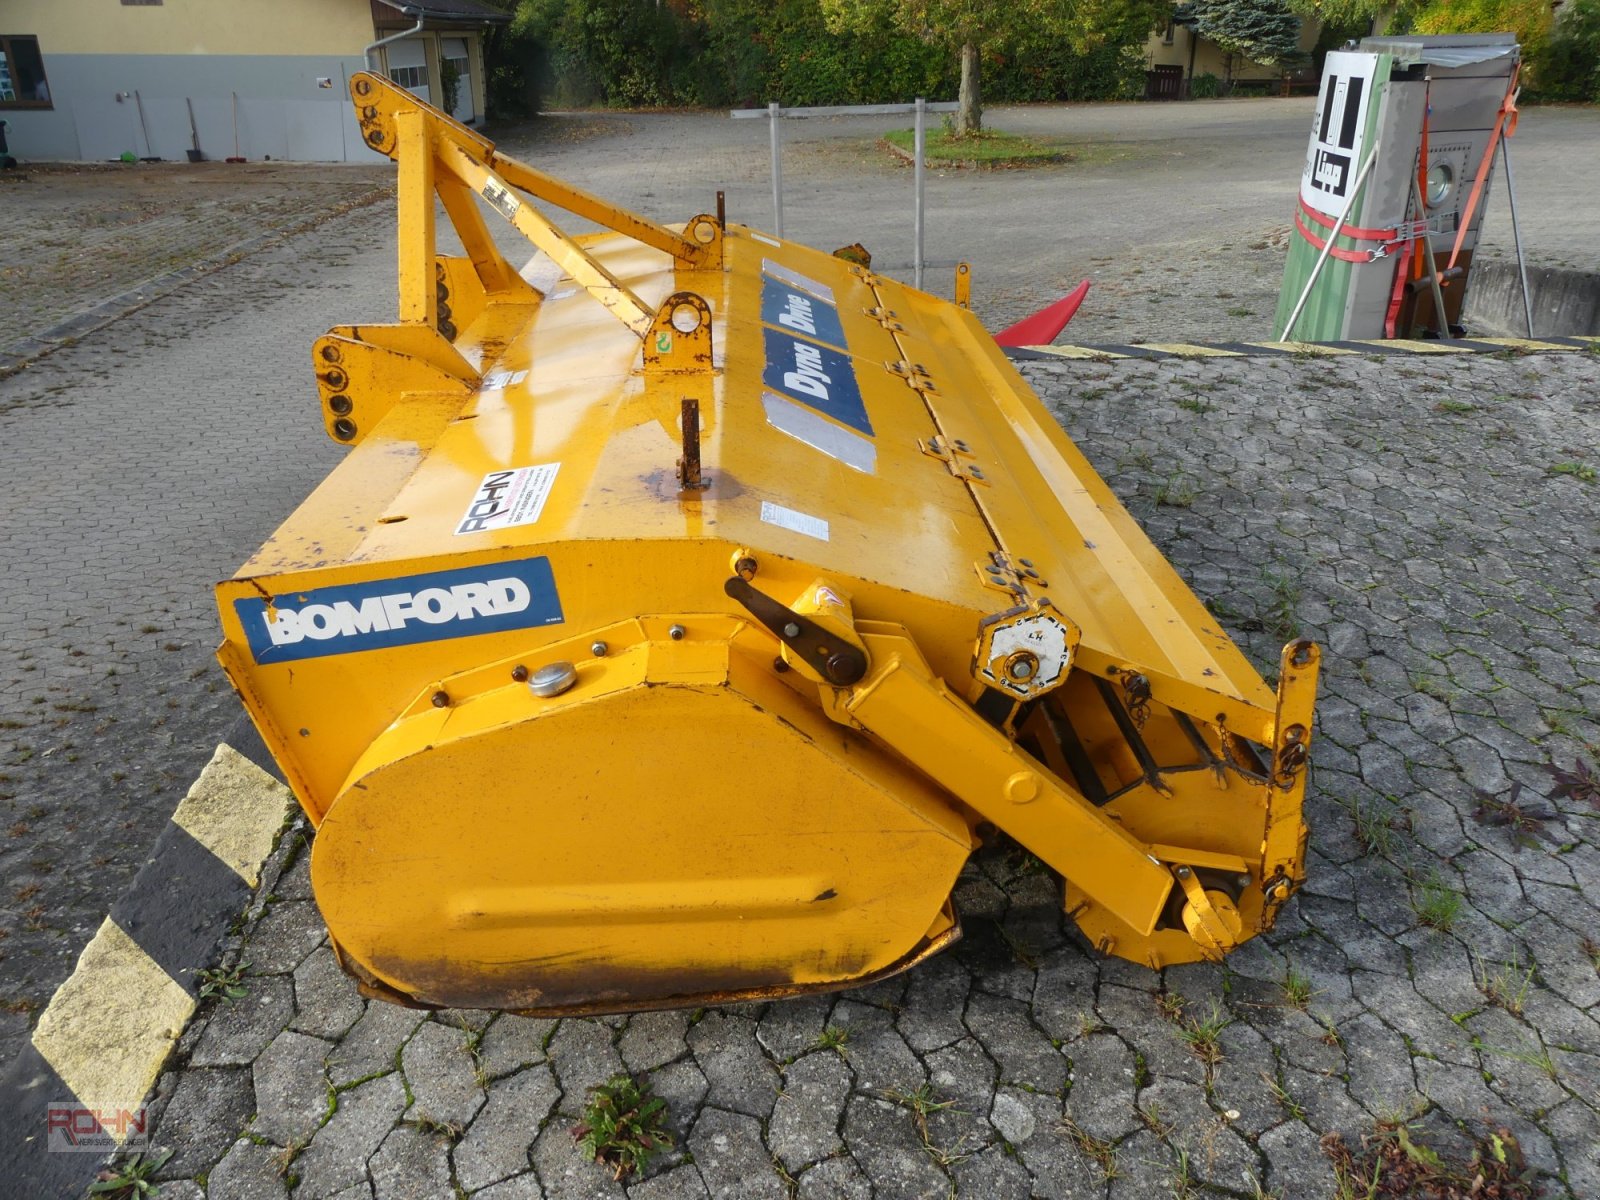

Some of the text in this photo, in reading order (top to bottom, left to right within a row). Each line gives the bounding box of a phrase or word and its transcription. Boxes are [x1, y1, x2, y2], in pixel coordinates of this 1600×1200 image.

[778, 294, 832, 401] Dyna Drive
[457, 471, 515, 534] ROHN
[261, 576, 531, 646] BOMFORD
[1028, 632, 1044, 641] LH
